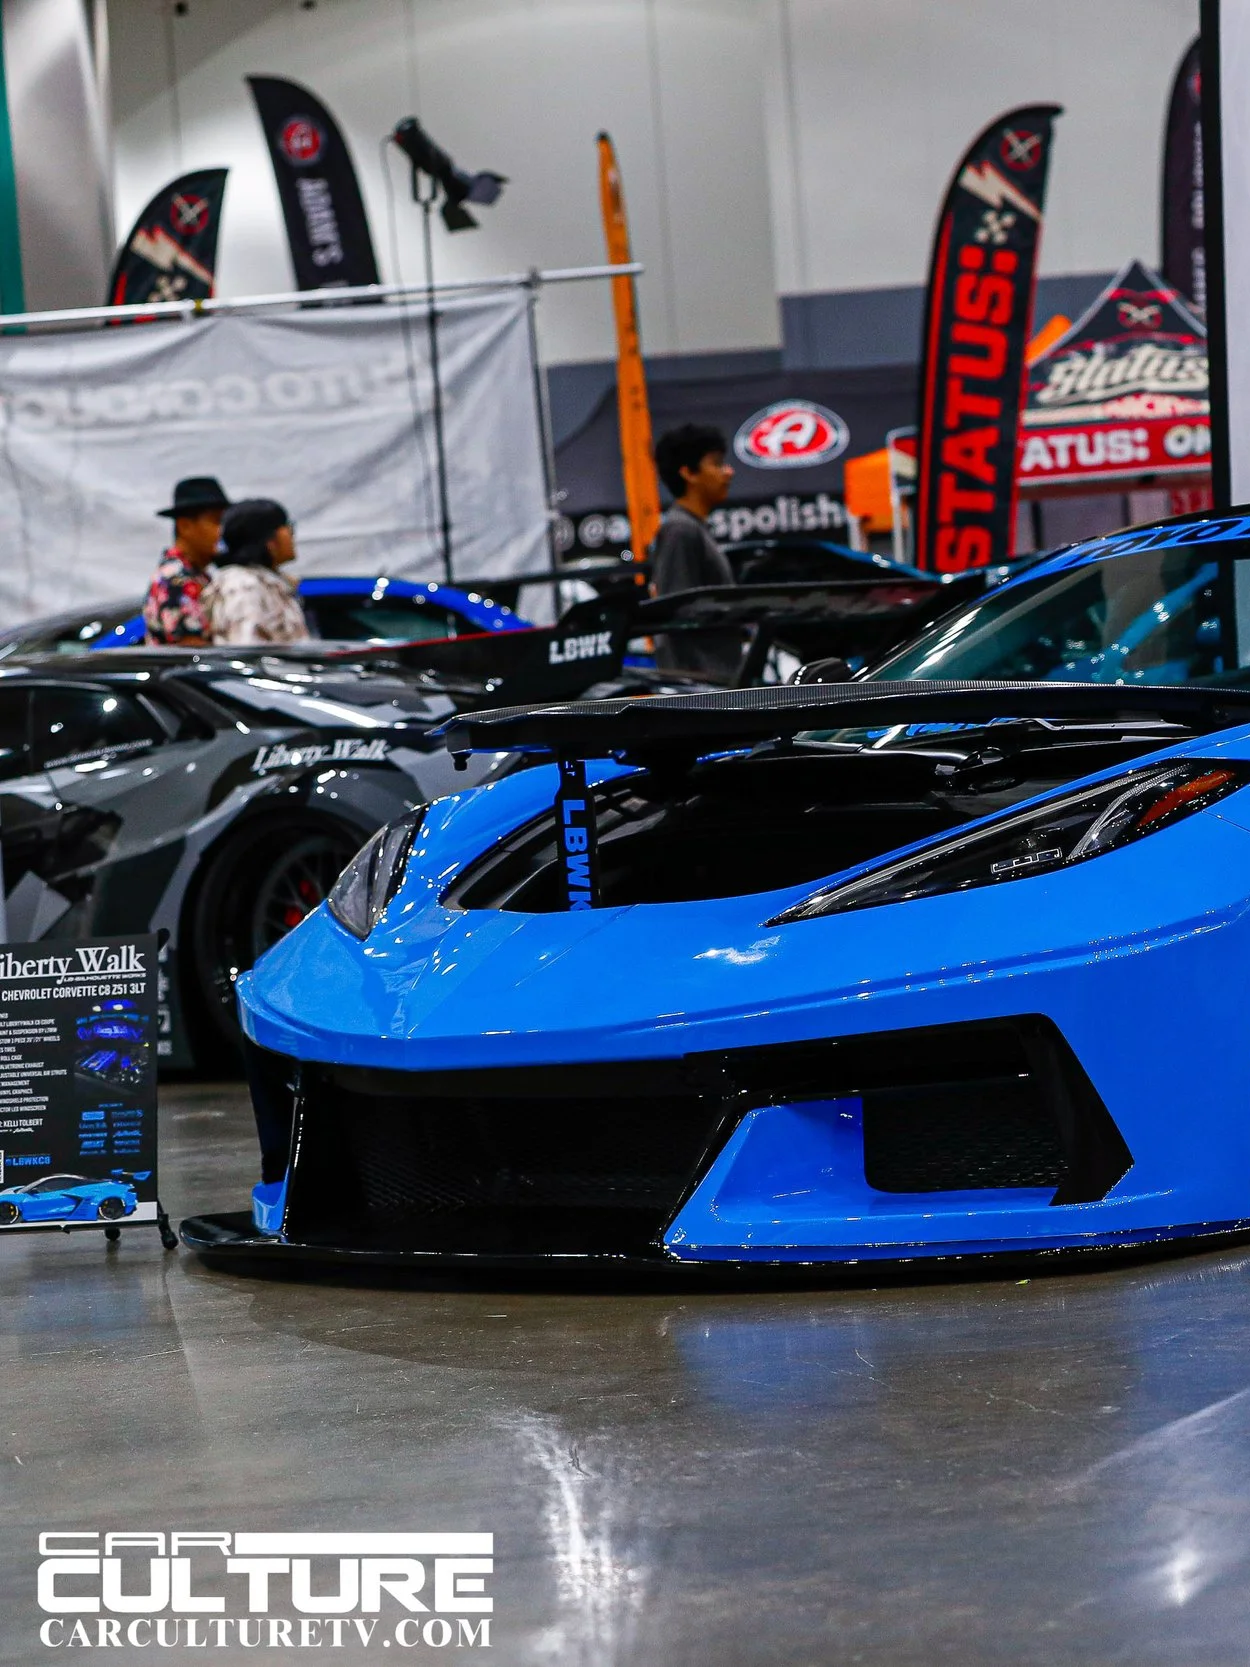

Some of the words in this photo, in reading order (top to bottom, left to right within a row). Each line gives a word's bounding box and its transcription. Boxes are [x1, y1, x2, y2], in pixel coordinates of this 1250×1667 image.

[935, 245, 1019, 573] STATUS:
[1021, 427, 1150, 472] ATUS:
[562, 800, 593, 911] LBWK
[0, 952, 73, 984] iberty
[75, 945, 147, 974] Walk
[1, 988, 52, 1002] CHEVROLET
[53, 985, 97, 999] CORVETTE
[98, 985, 110, 996] C8
[111, 983, 128, 995] Z51
[129, 982, 147, 994] 3LT
